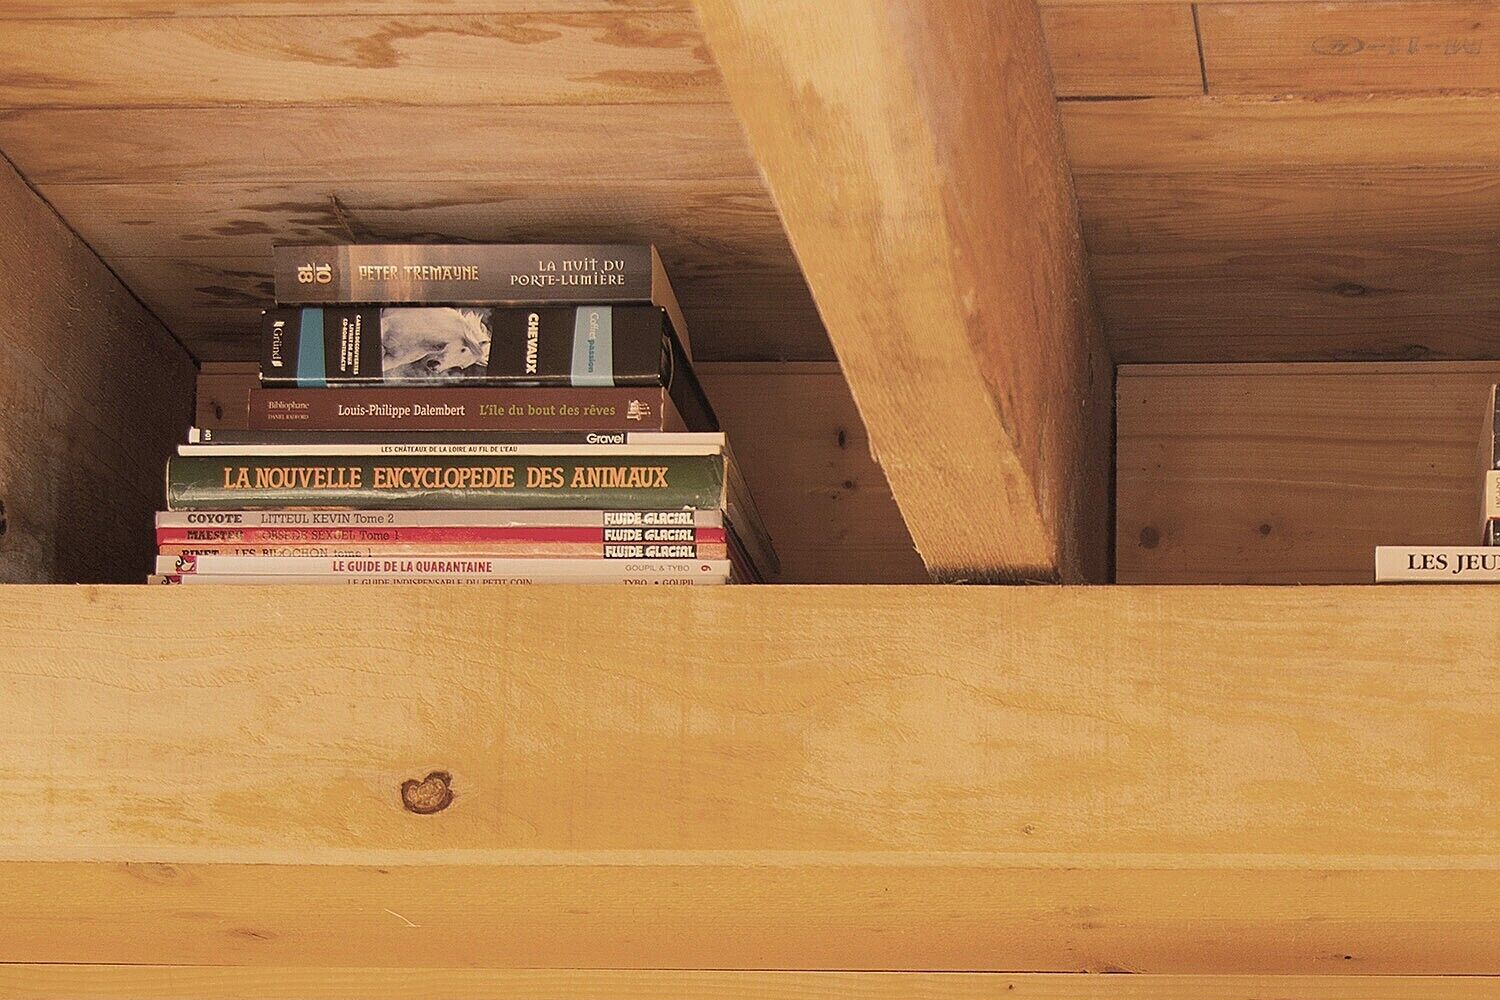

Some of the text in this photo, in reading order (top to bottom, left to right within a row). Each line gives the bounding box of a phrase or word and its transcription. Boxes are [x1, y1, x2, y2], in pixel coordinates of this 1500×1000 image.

[539, 261, 556, 271] LA
[603, 260, 624, 271] DU
[359, 266, 479, 281] PETER TREMAYNE
[511, 270, 625, 287] PORTE-LUMIÈRE
[526, 313, 540, 374] CHEVAUX
[338, 404, 465, 418] Louis-Philippe Dalembert
[509, 405, 524, 416] du
[528, 405, 555, 416] bout
[560, 405, 579, 416] des
[584, 405, 615, 416] rêves
[587, 433, 624, 444] Gravel
[224, 467, 669, 488] LA NOUVELLE ENCYCLOPEDIE DES ANIMAUX
[187, 514, 394, 524] COYOTE LITTEUL KEVIN Tome 2
[605, 512, 694, 525] FLUIDE GLACIAL
[333, 561, 492, 572] LE GUIDE DE LA QUARANTAINE
[1407, 554, 1448, 570] LES
